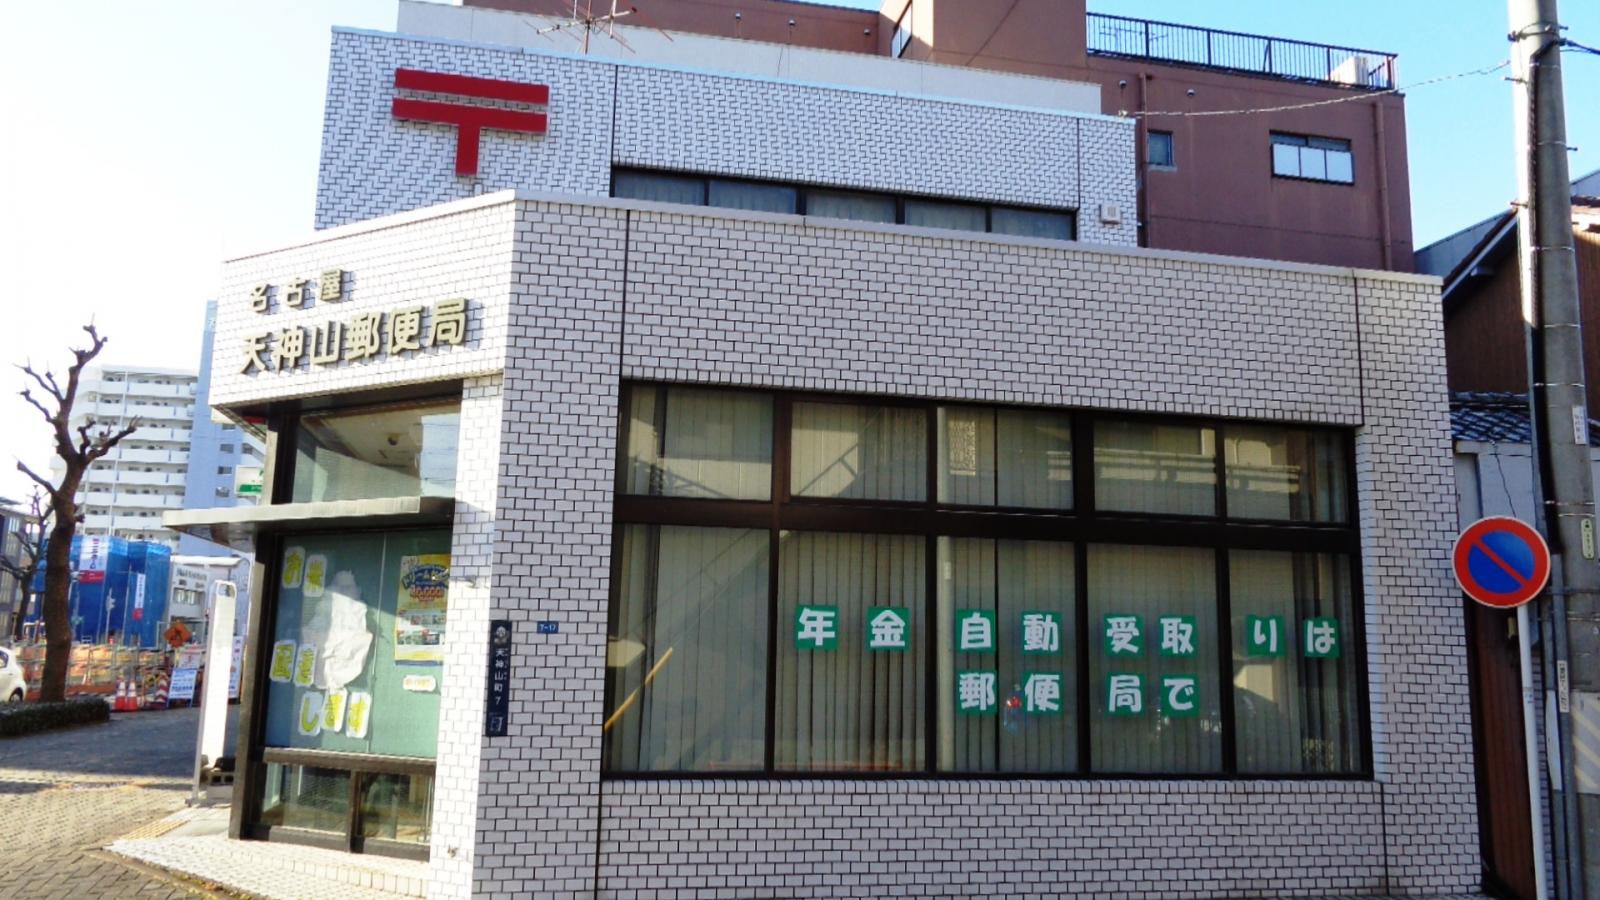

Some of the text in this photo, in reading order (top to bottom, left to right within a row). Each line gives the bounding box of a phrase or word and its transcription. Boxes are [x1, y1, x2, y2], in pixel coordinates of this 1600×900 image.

[250, 267, 342, 313] 名古屋
[240, 297, 468, 375] 天神山郵便局
[797, 607, 1337, 655] 年金自動受取りは
[958, 672, 1195, 714] 郵便局で
